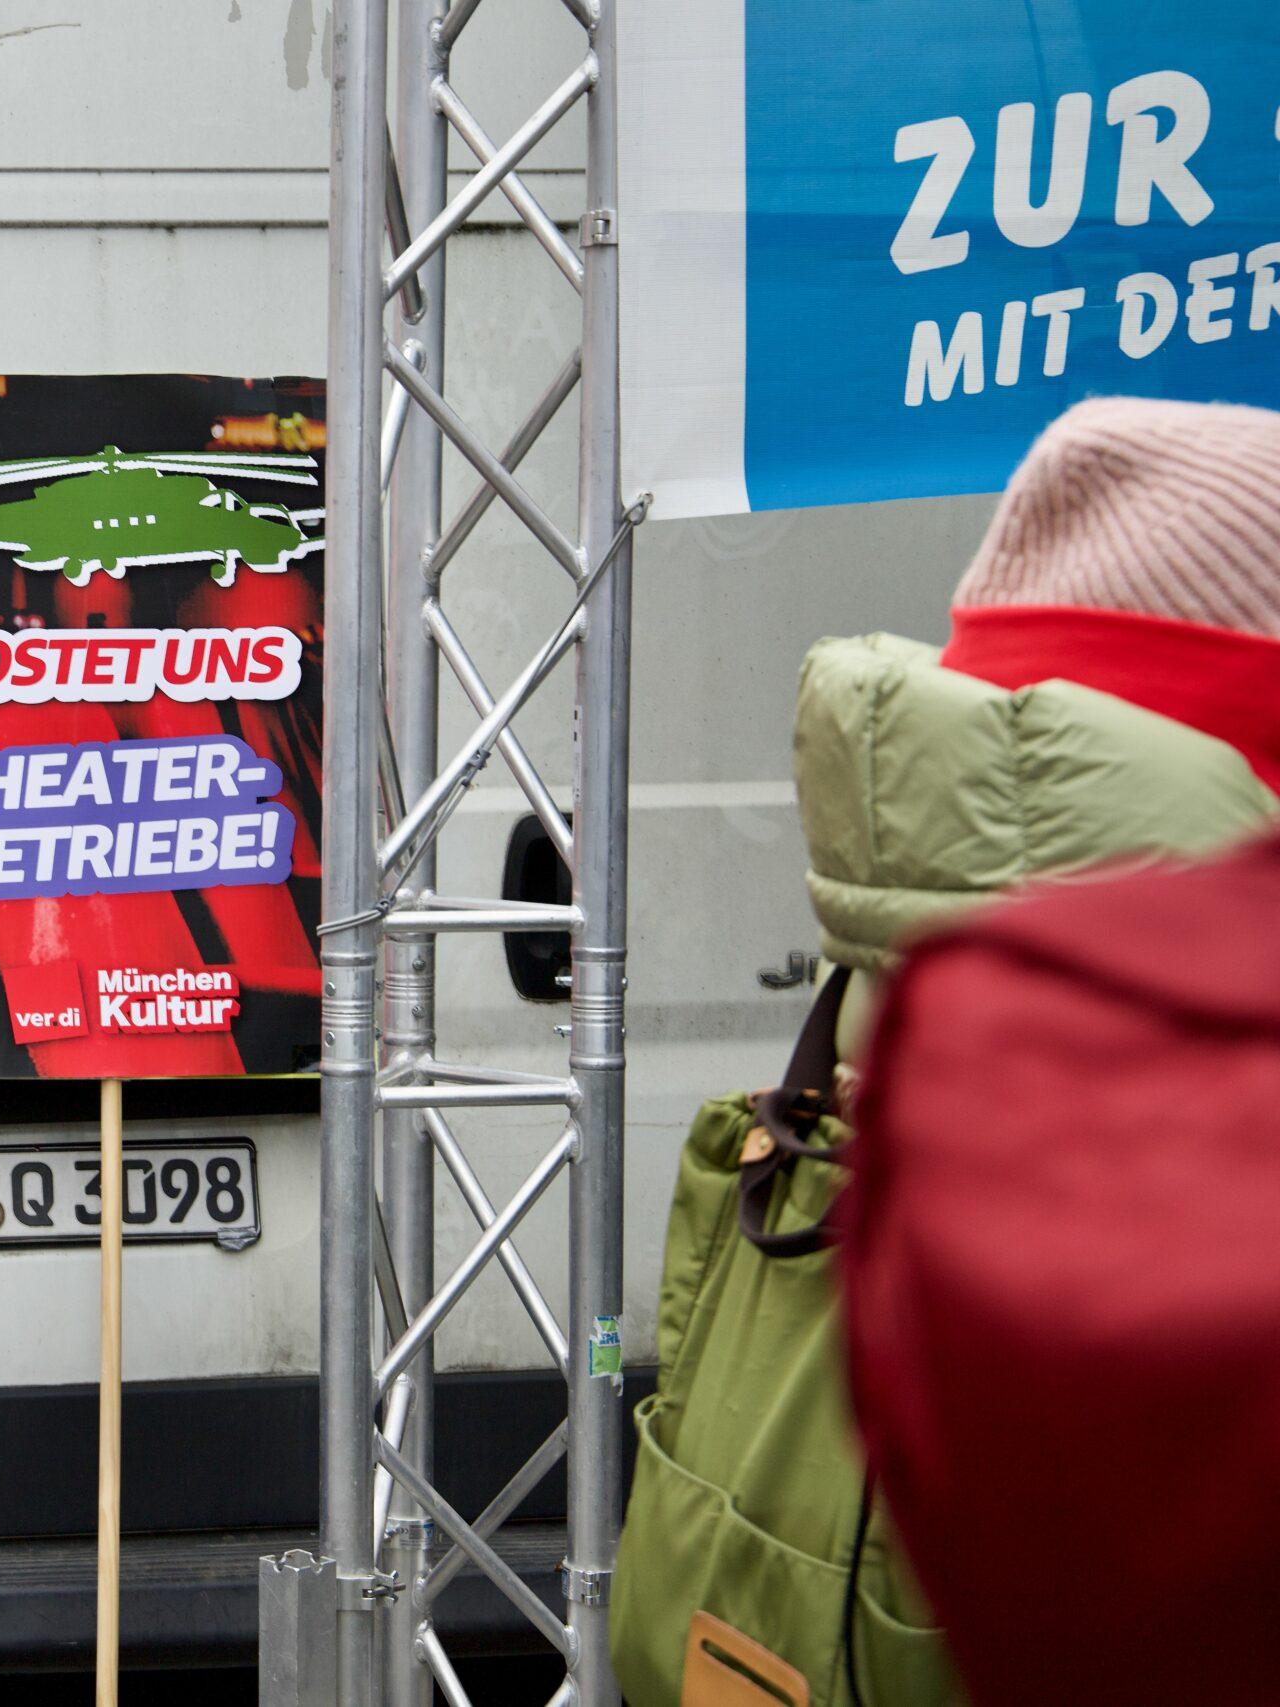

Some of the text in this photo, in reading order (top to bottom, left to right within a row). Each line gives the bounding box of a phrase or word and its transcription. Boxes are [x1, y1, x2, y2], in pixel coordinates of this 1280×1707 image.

[890, 70, 1215, 275] ZUR
[904, 287, 1086, 407] MIT
[162, 636, 285, 685] UNS
[97, 968, 232, 993] München
[98, 994, 233, 1027] Kultur
[11, 1161, 54, 1227] Q
[74, 1157, 245, 1225] 3098
